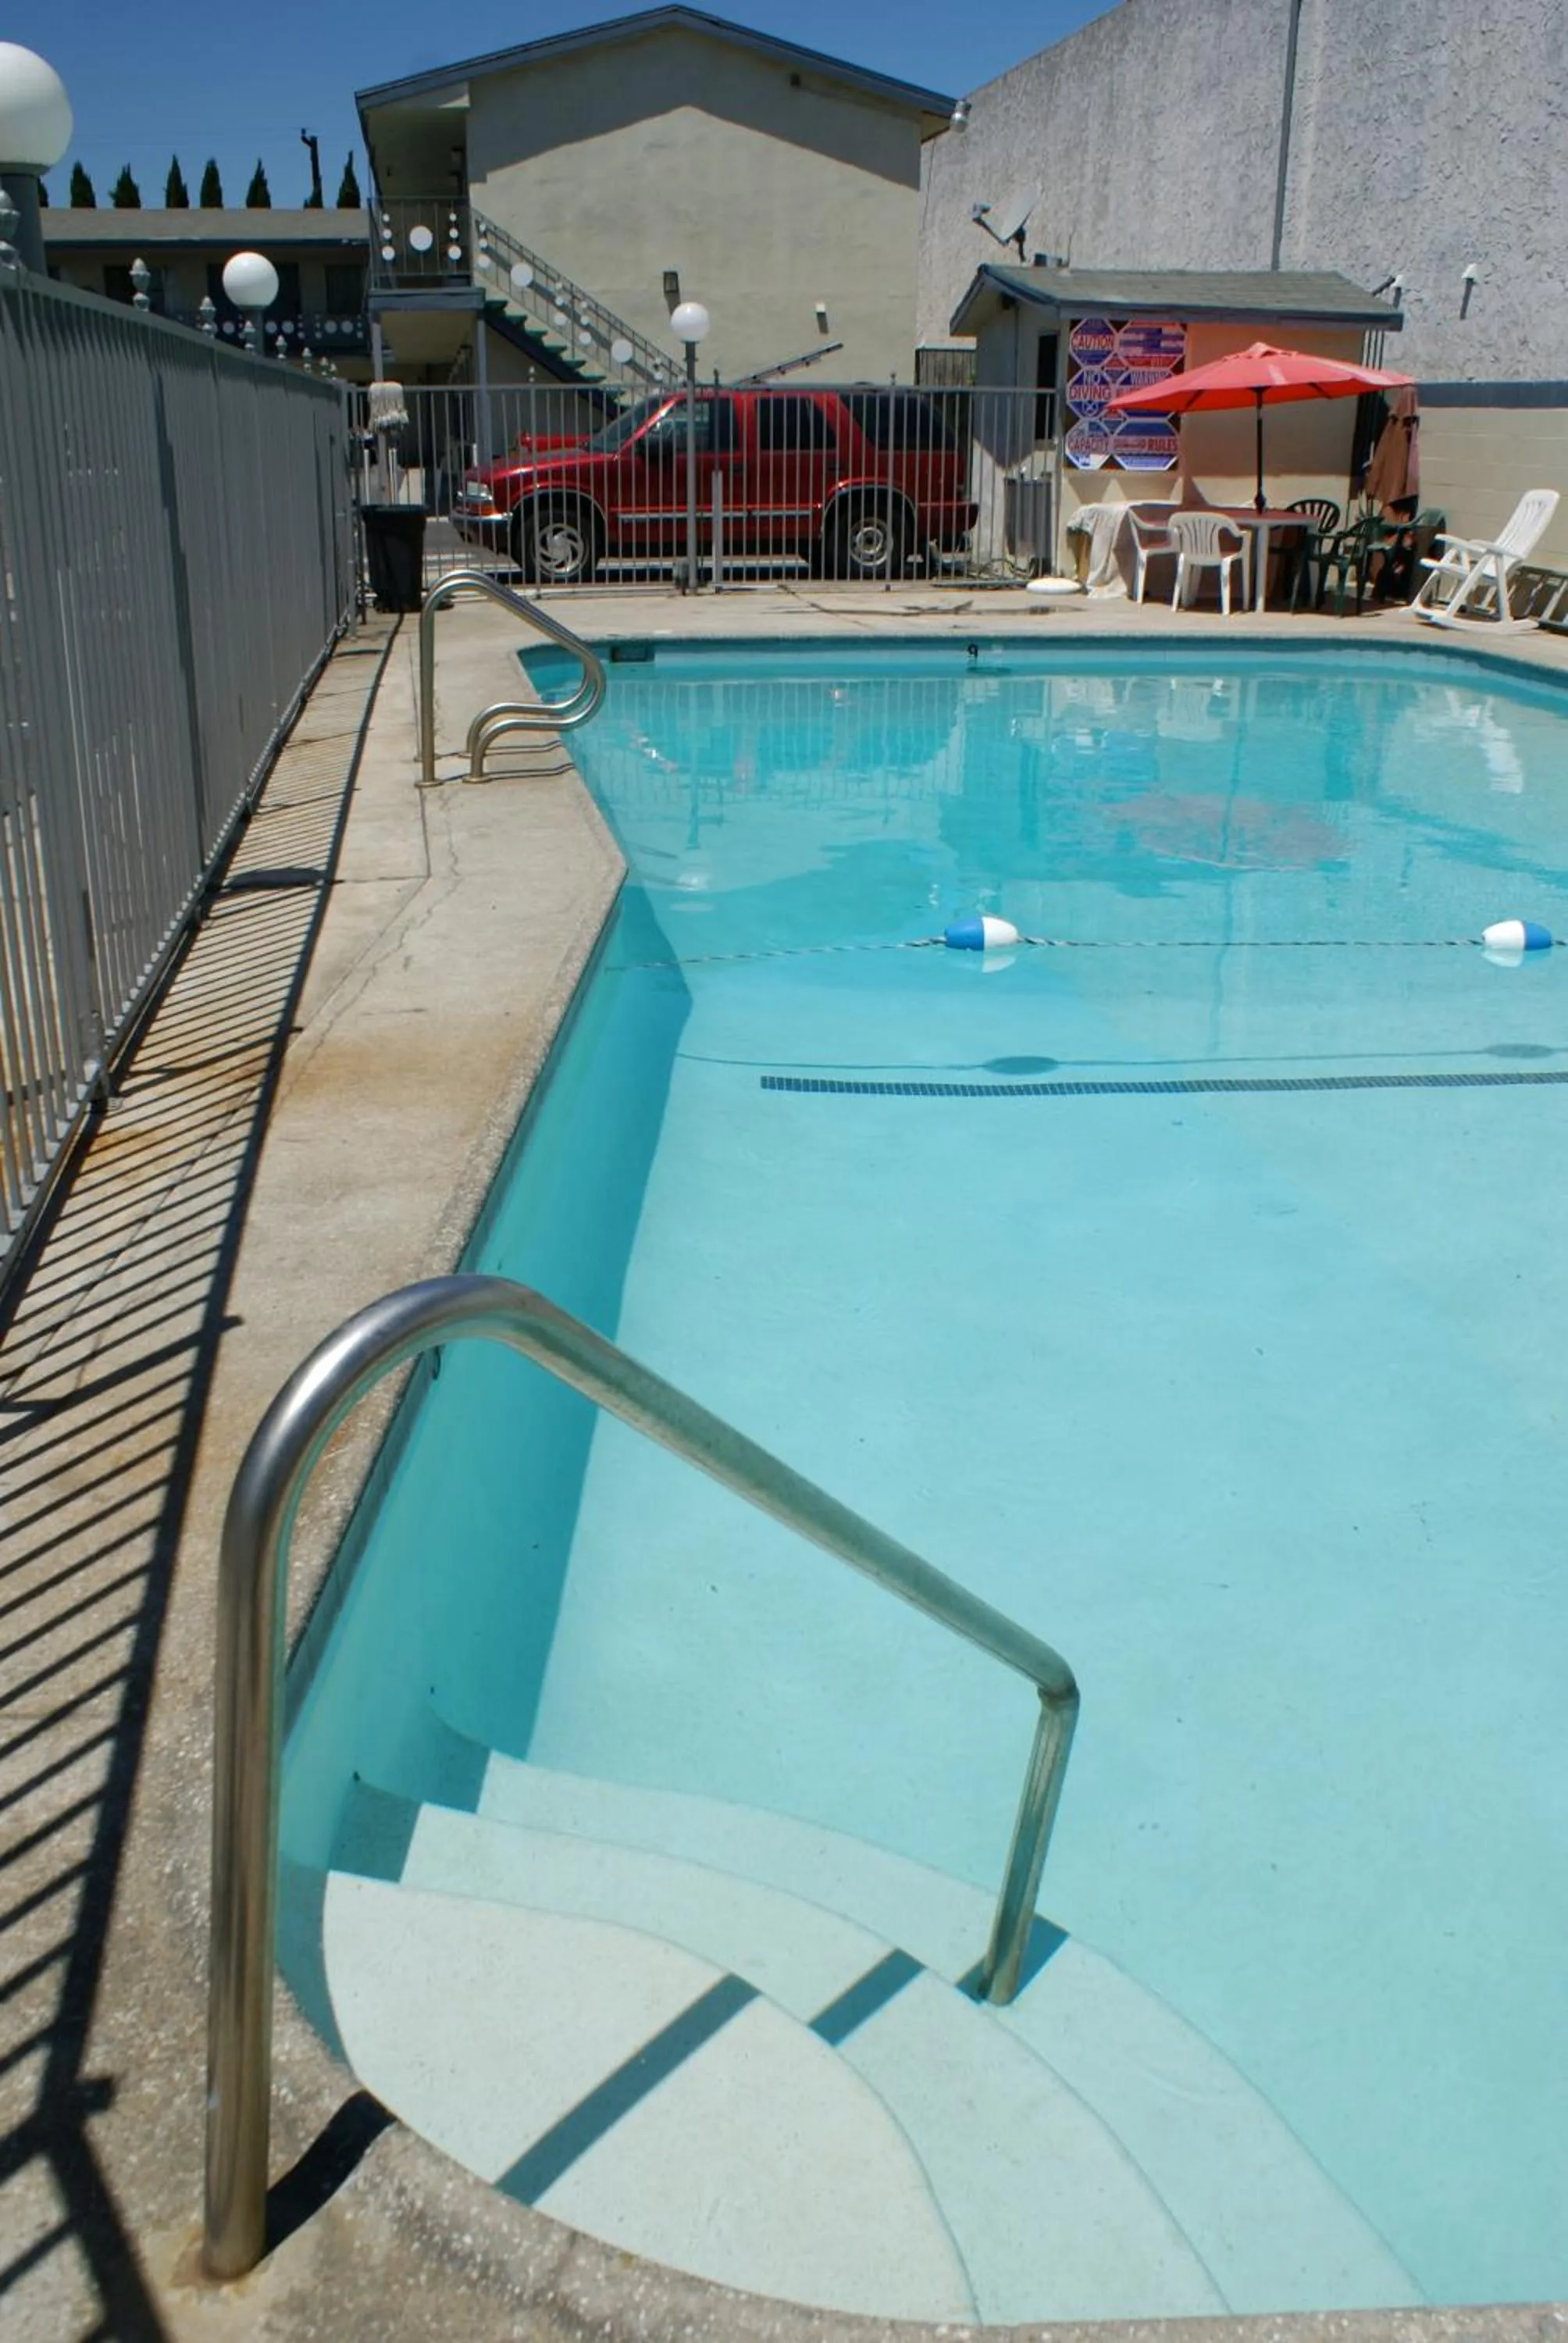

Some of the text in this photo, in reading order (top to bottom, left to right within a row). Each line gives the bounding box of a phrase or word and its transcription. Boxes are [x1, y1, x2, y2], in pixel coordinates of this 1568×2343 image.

[1084, 370, 1102, 385] NO
[1069, 387, 1111, 400] DIVING
[1067, 438, 1109, 451] CAPACITY
[1147, 438, 1178, 451] RULES
